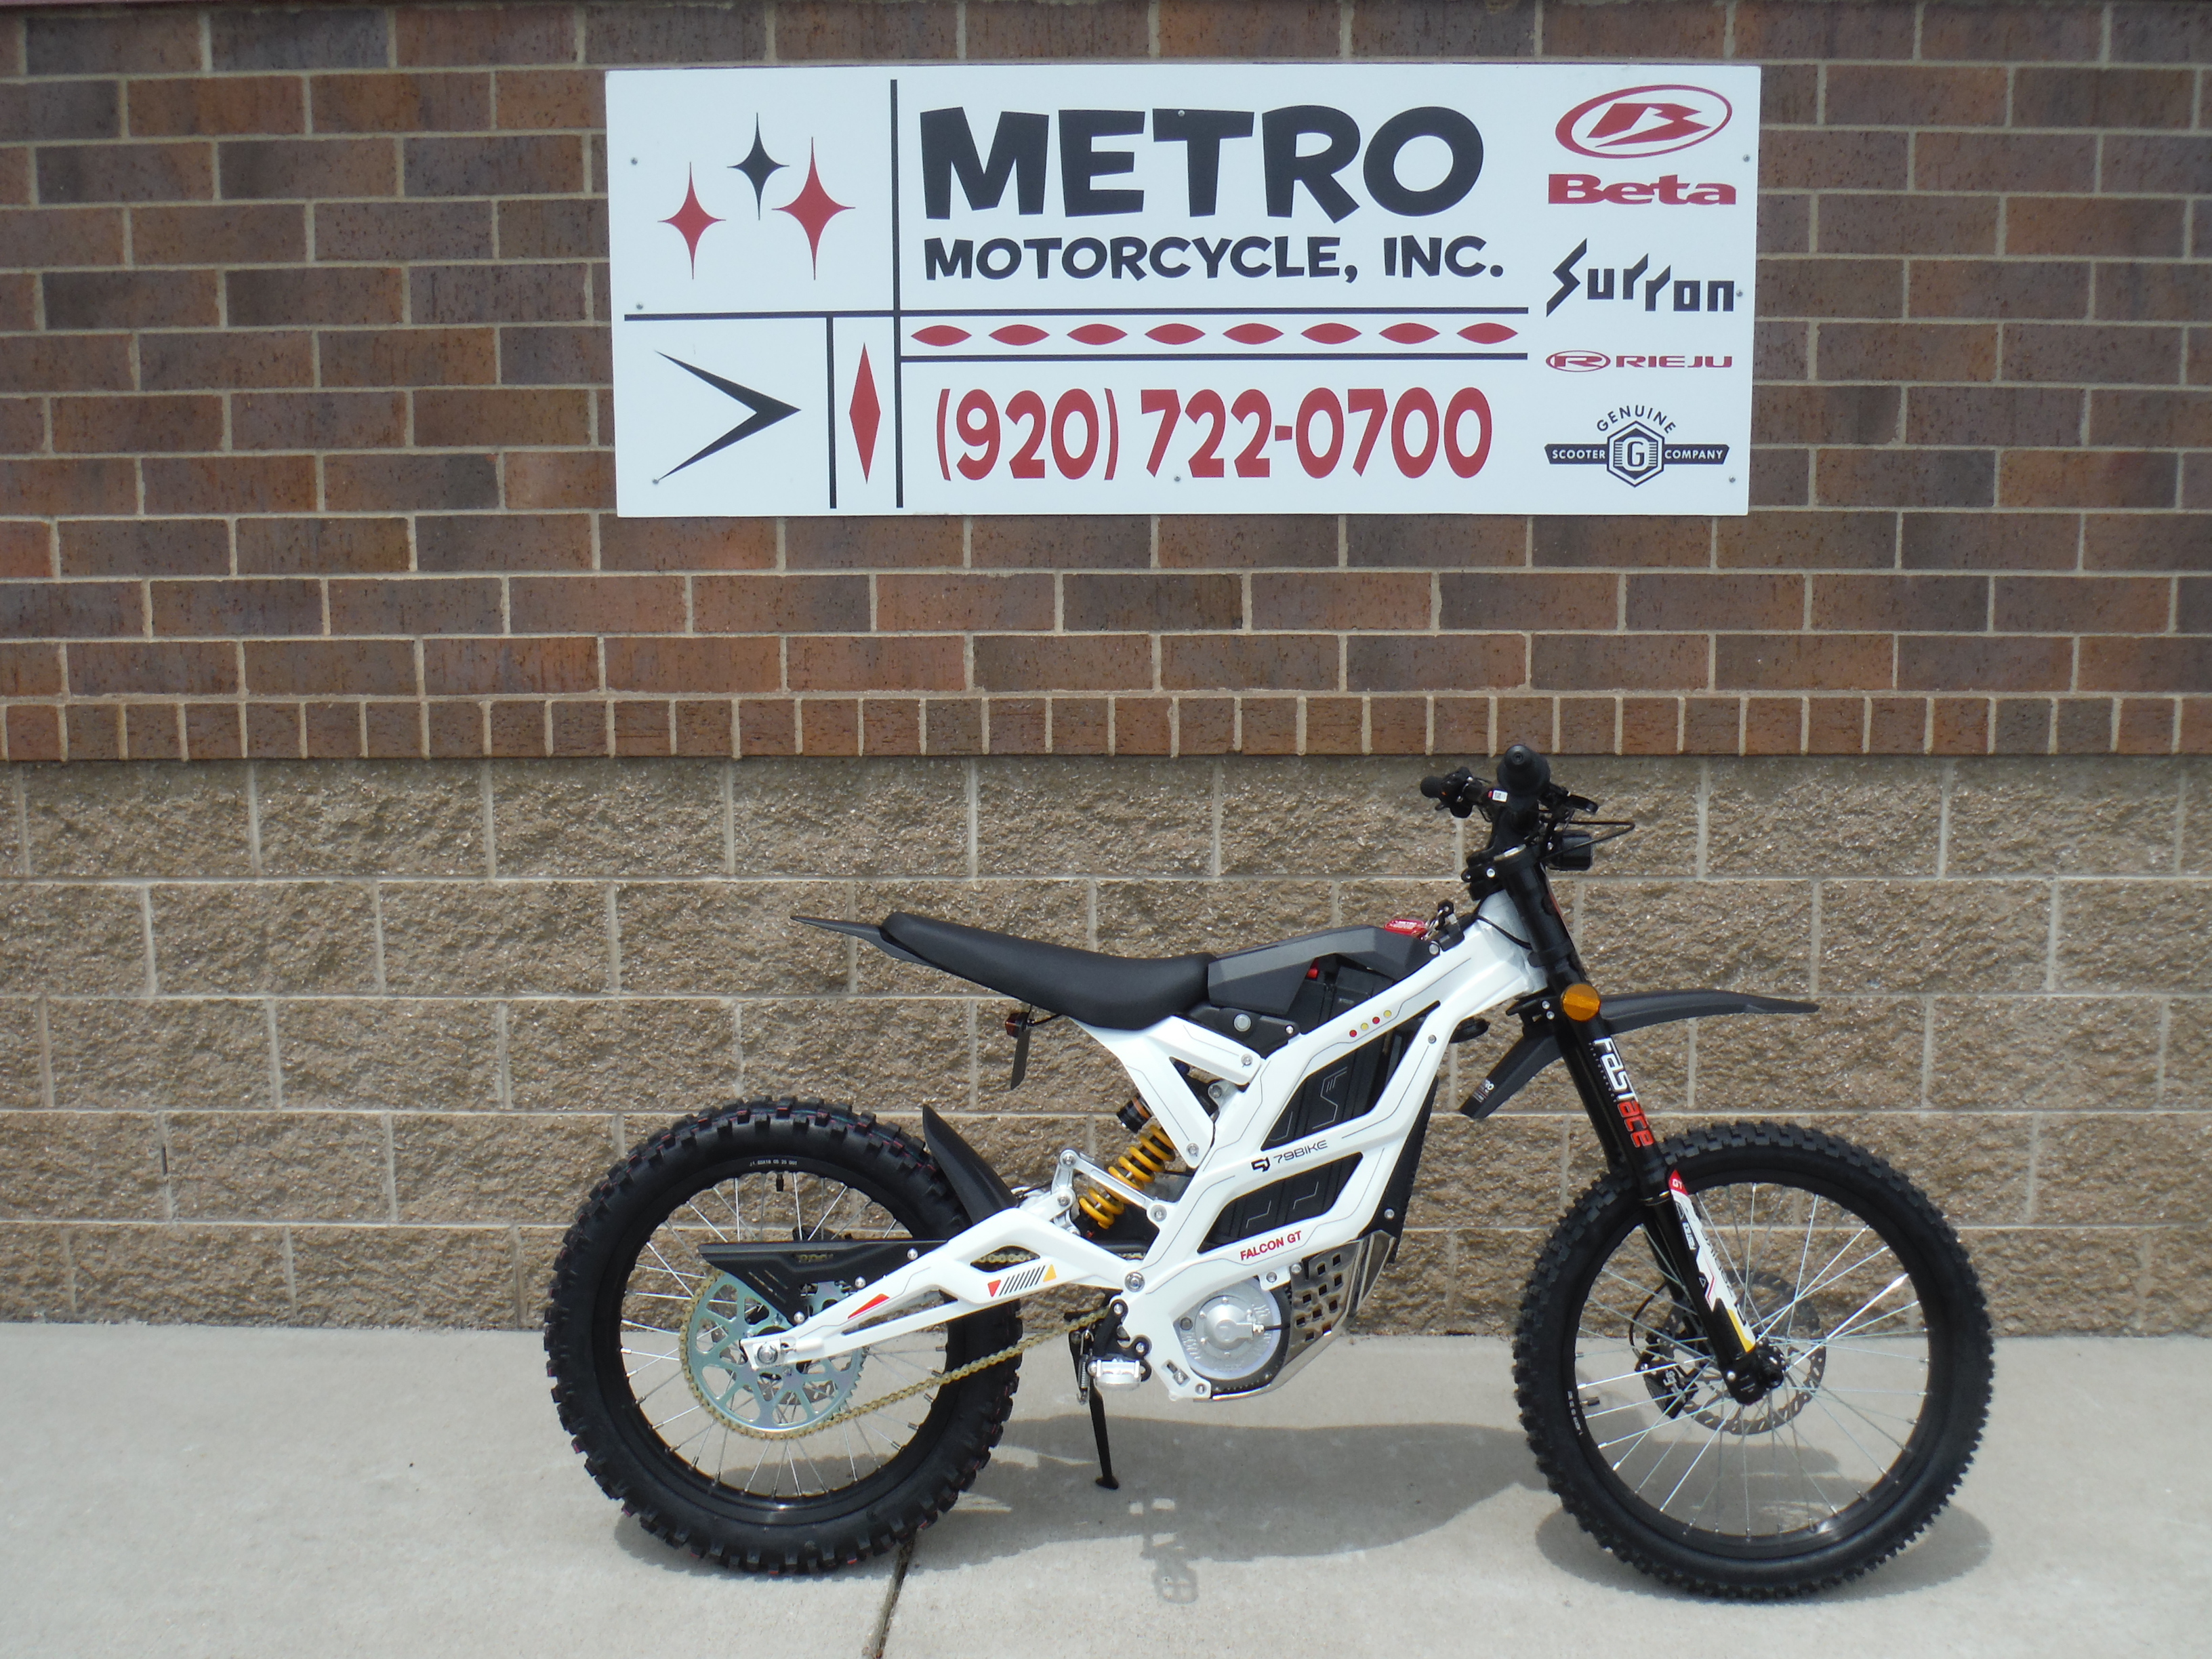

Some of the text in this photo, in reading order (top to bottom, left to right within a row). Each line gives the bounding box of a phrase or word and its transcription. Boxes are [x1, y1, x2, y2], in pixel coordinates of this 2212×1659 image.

[920, 104, 1484, 224] METRO
[1548, 173, 1737, 205] Beta
[924, 234, 1504, 284] MOTORCYCLE, INC.
[1546, 237, 1735, 318] Surron
[1616, 355, 1733, 368] RIEJU
[936, 386, 1493, 482] (920) 722-0700
[1597, 404, 1677, 434] GENUINE
[1551, 441, 1724, 467] SCOOTER G COMPANY
[1273, 1139, 1328, 1164] 79BIKE
[1240, 1230, 1302, 1261] FALCON GT
